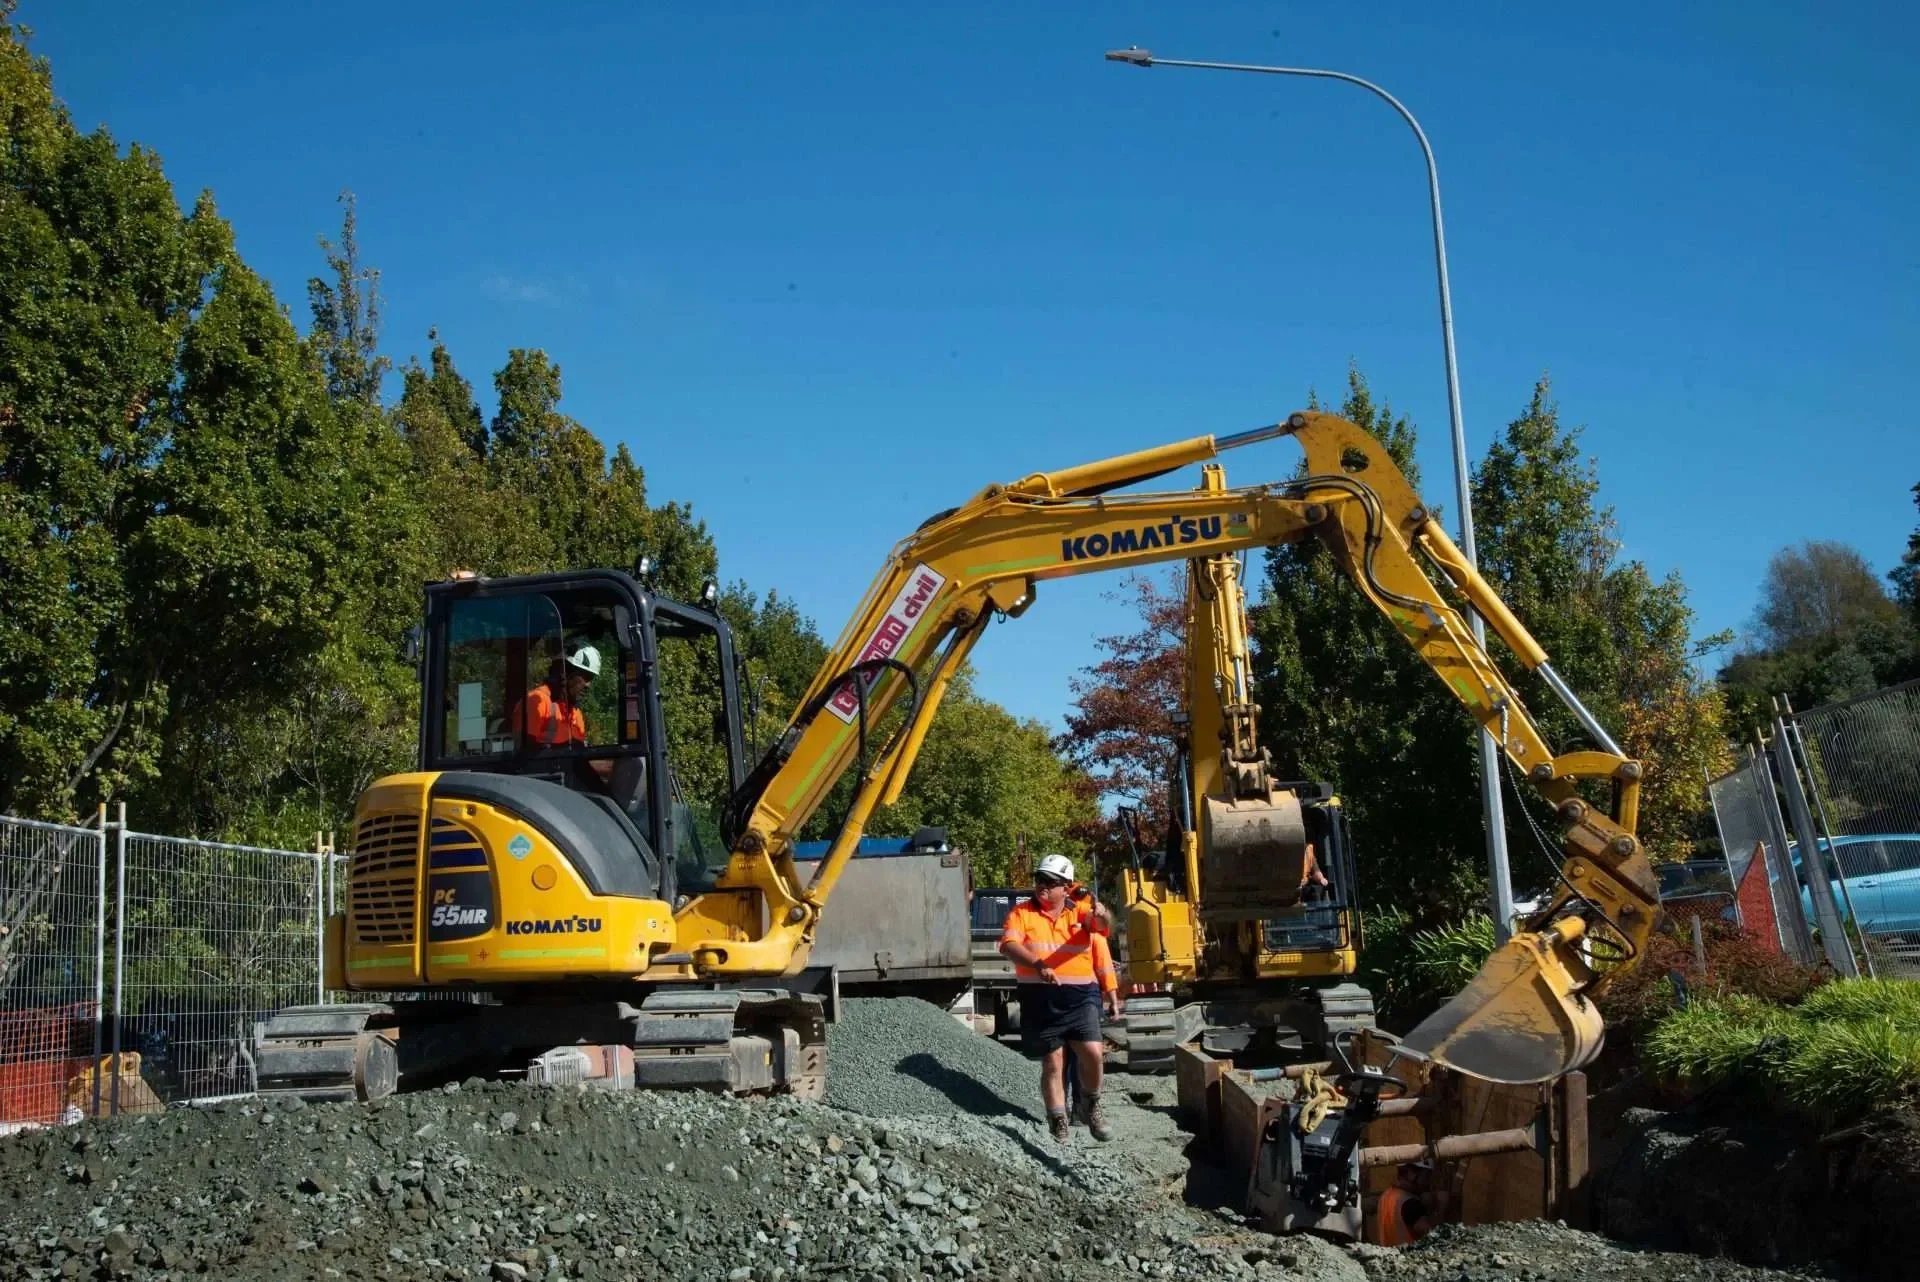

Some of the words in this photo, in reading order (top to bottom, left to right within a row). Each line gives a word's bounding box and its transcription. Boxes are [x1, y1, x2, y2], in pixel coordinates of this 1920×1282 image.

[1062, 515, 1222, 561] KOMATSU
[904, 574, 937, 618] civil
[433, 888, 456, 904] PC
[431, 905, 488, 927] 55MR
[506, 914, 602, 935] KOMATSU
